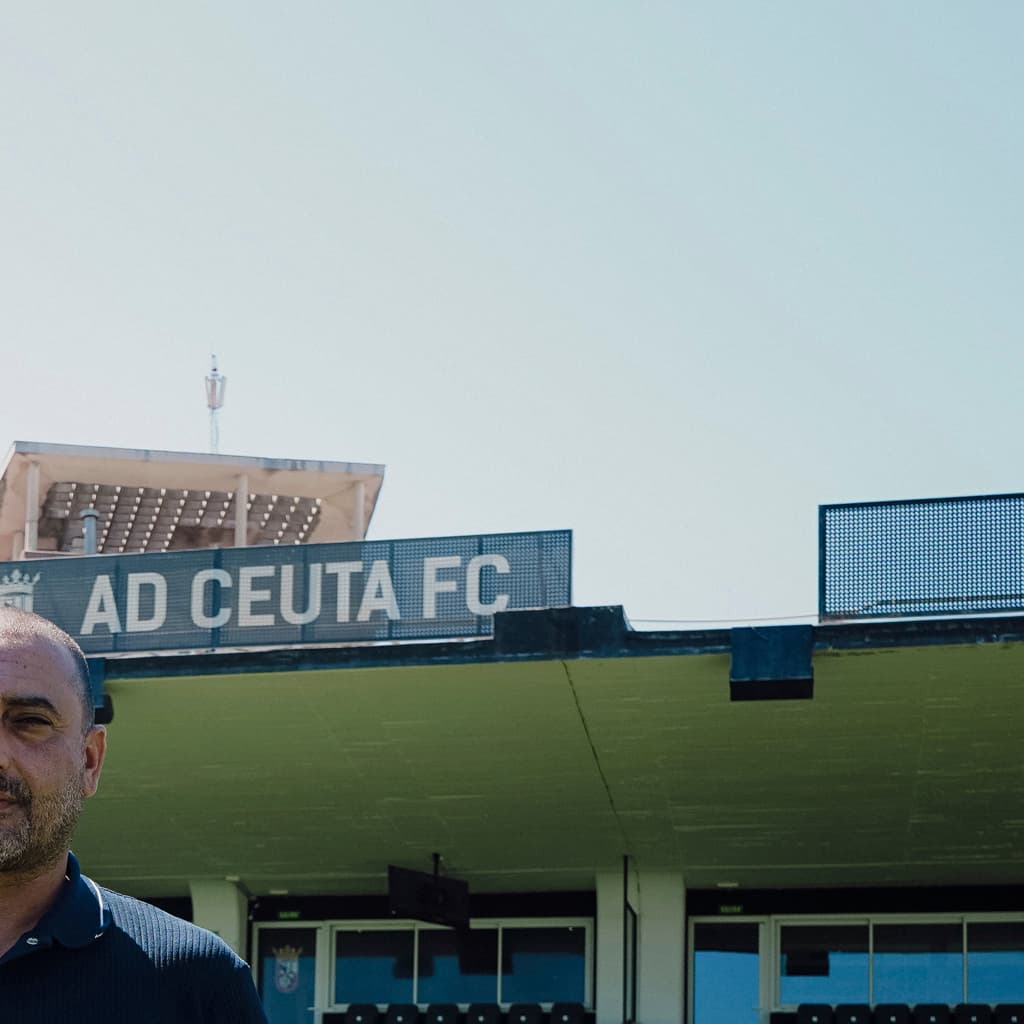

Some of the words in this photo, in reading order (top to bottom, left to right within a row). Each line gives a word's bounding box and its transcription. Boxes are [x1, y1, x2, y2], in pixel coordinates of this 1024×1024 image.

[79, 571, 168, 635] AD
[190, 559, 401, 629] CEUTA
[422, 554, 511, 619] FC
